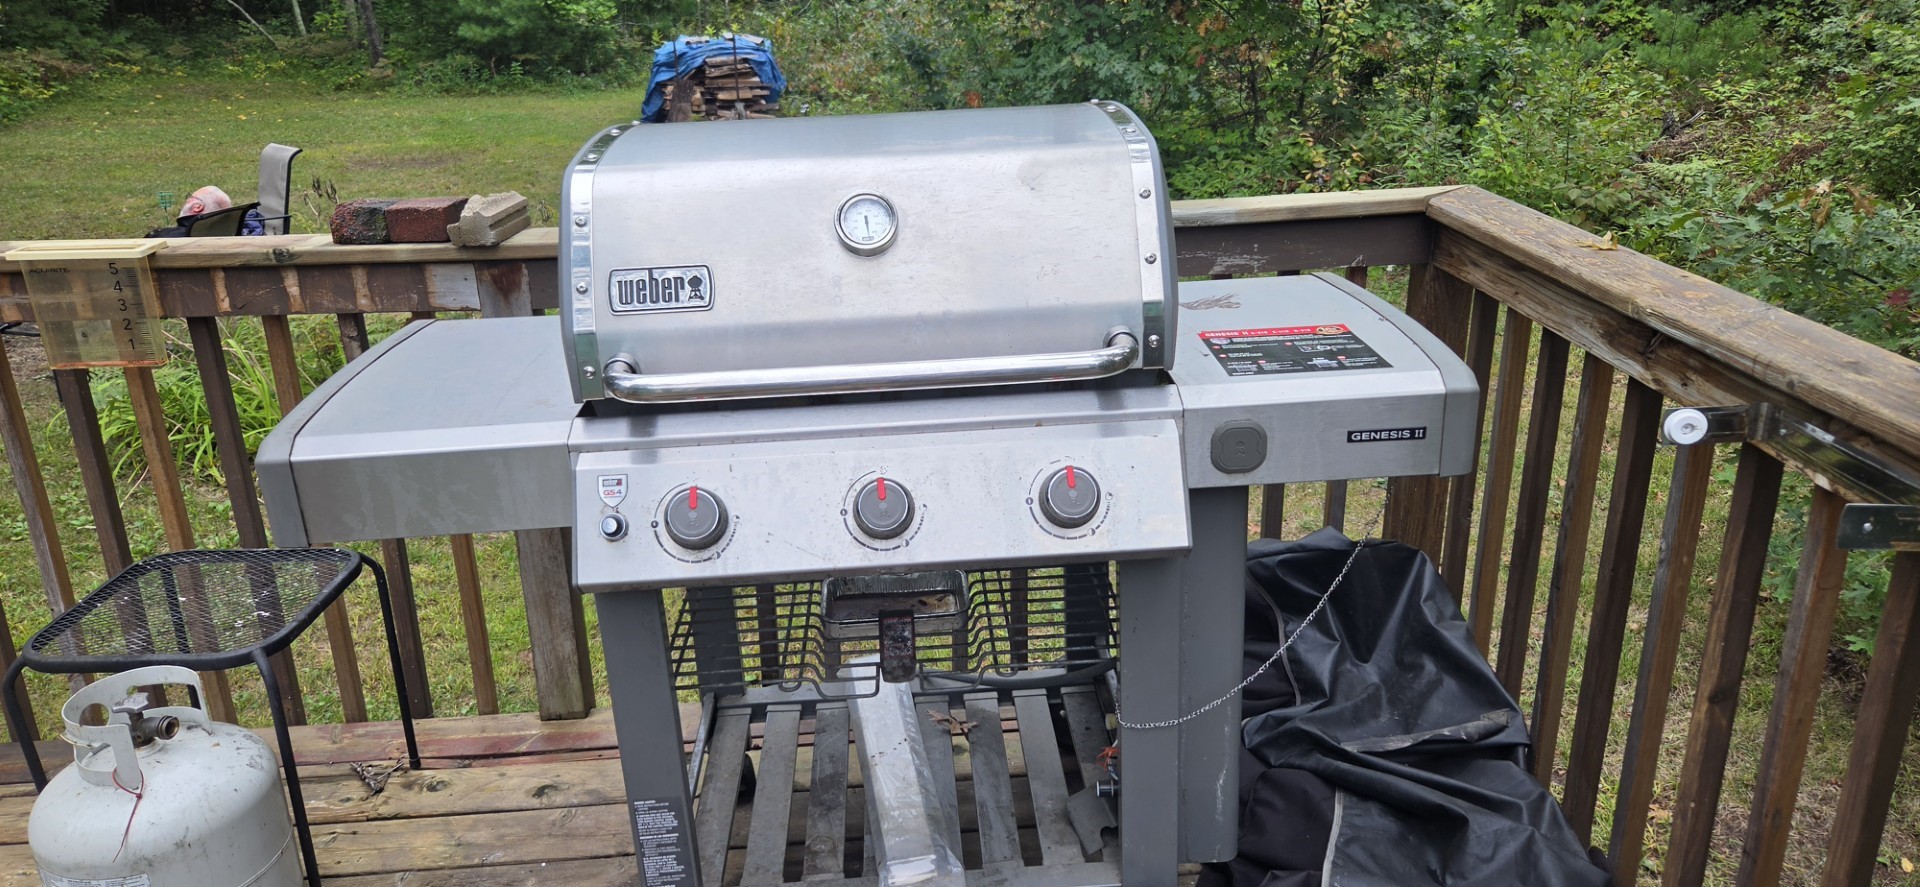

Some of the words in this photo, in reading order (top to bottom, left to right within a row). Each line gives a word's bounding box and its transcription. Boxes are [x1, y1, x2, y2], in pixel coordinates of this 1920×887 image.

[108, 262, 119, 275] 5
[113, 280, 123, 293] 4
[616, 269, 685, 305] weber
[117, 298, 128, 312] 3
[122, 318, 133, 331] 2
[128, 338, 135, 350] 1
[1351, 430, 1411, 441] GENESIS
[1414, 429, 1424, 438] II
